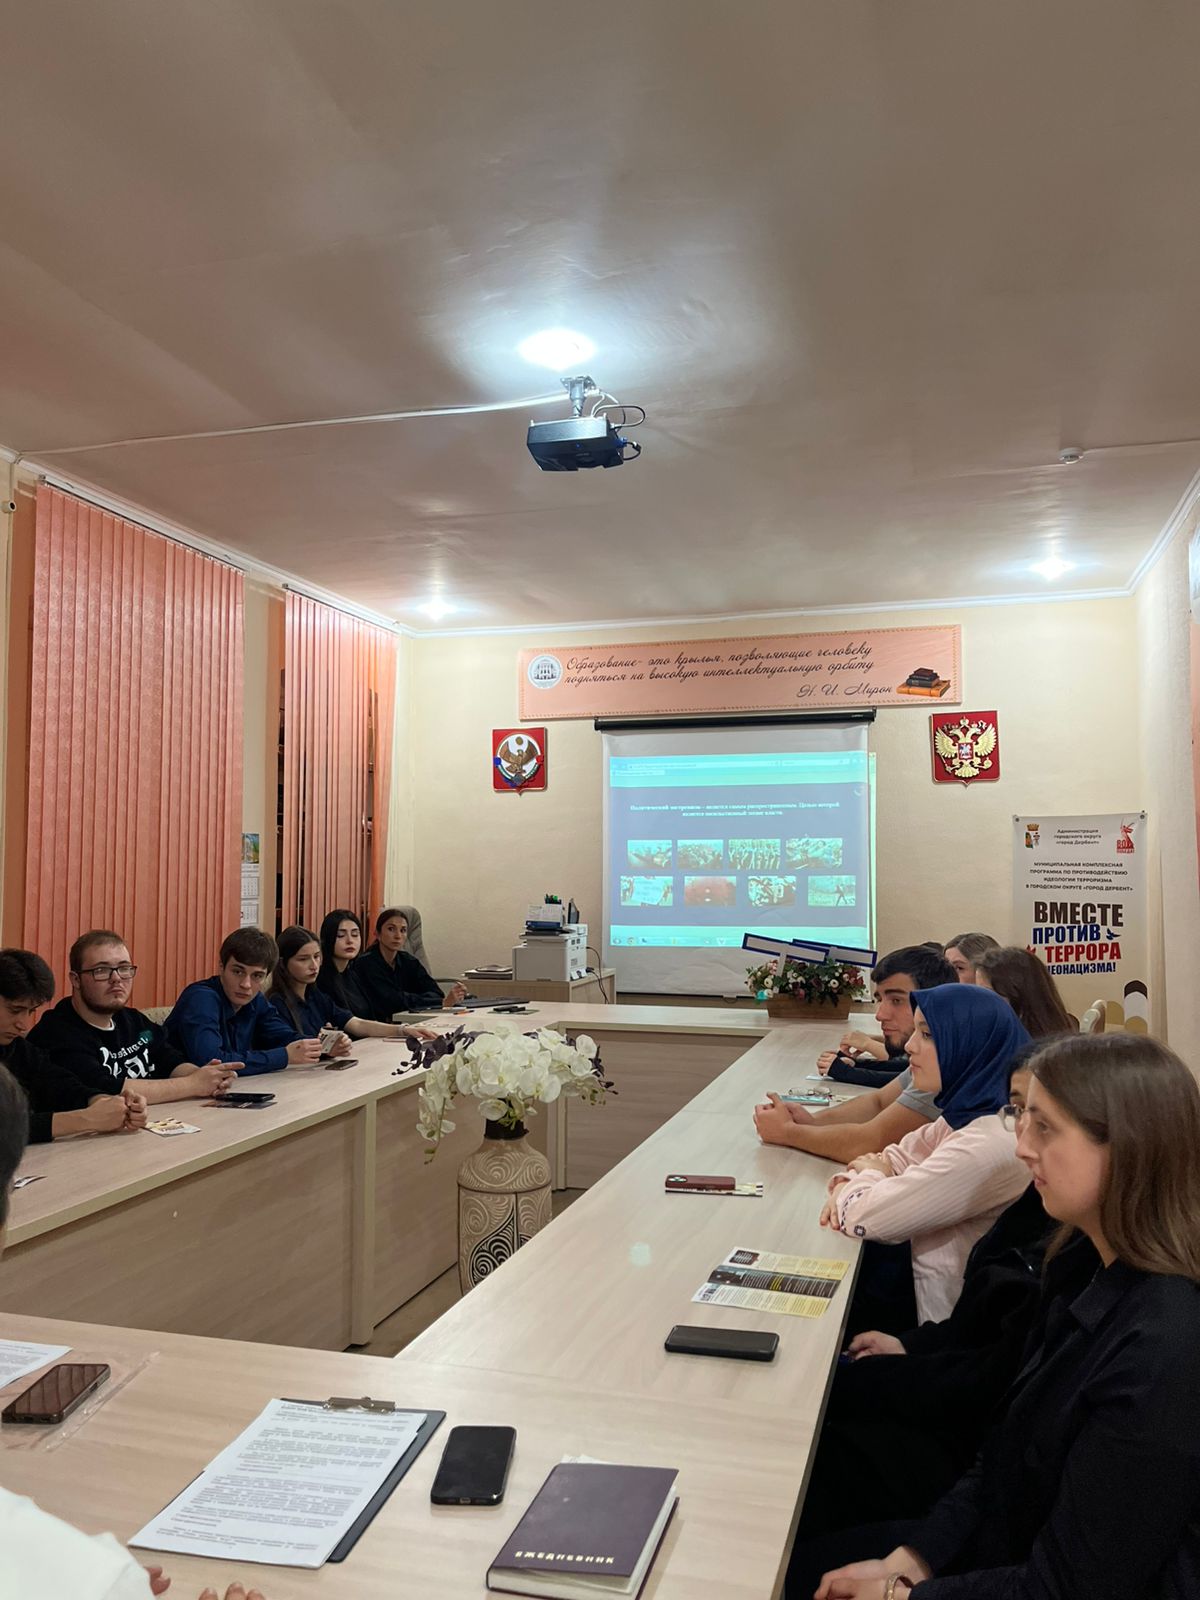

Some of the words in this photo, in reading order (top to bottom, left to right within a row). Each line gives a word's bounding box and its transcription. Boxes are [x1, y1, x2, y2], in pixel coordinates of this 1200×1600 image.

[648, 657, 670, 666] это
[728, 648, 812, 666] позволяющие
[817, 641, 873, 657] человеку
[564, 673, 626, 688] подняться
[649, 666, 698, 683] высокую
[702, 661, 823, 678] интеллектуальную
[828, 658, 874, 675] орбиту
[844, 683, 892, 698] Мирон
[1034, 901, 1124, 927] ВМЕСТЕ
[1032, 924, 1101, 944] ПРОТИВ
[1044, 942, 1122, 963] ТЕРРОРА
[514, 1550, 615, 1564] ЕЖЕДНЕВНИК
